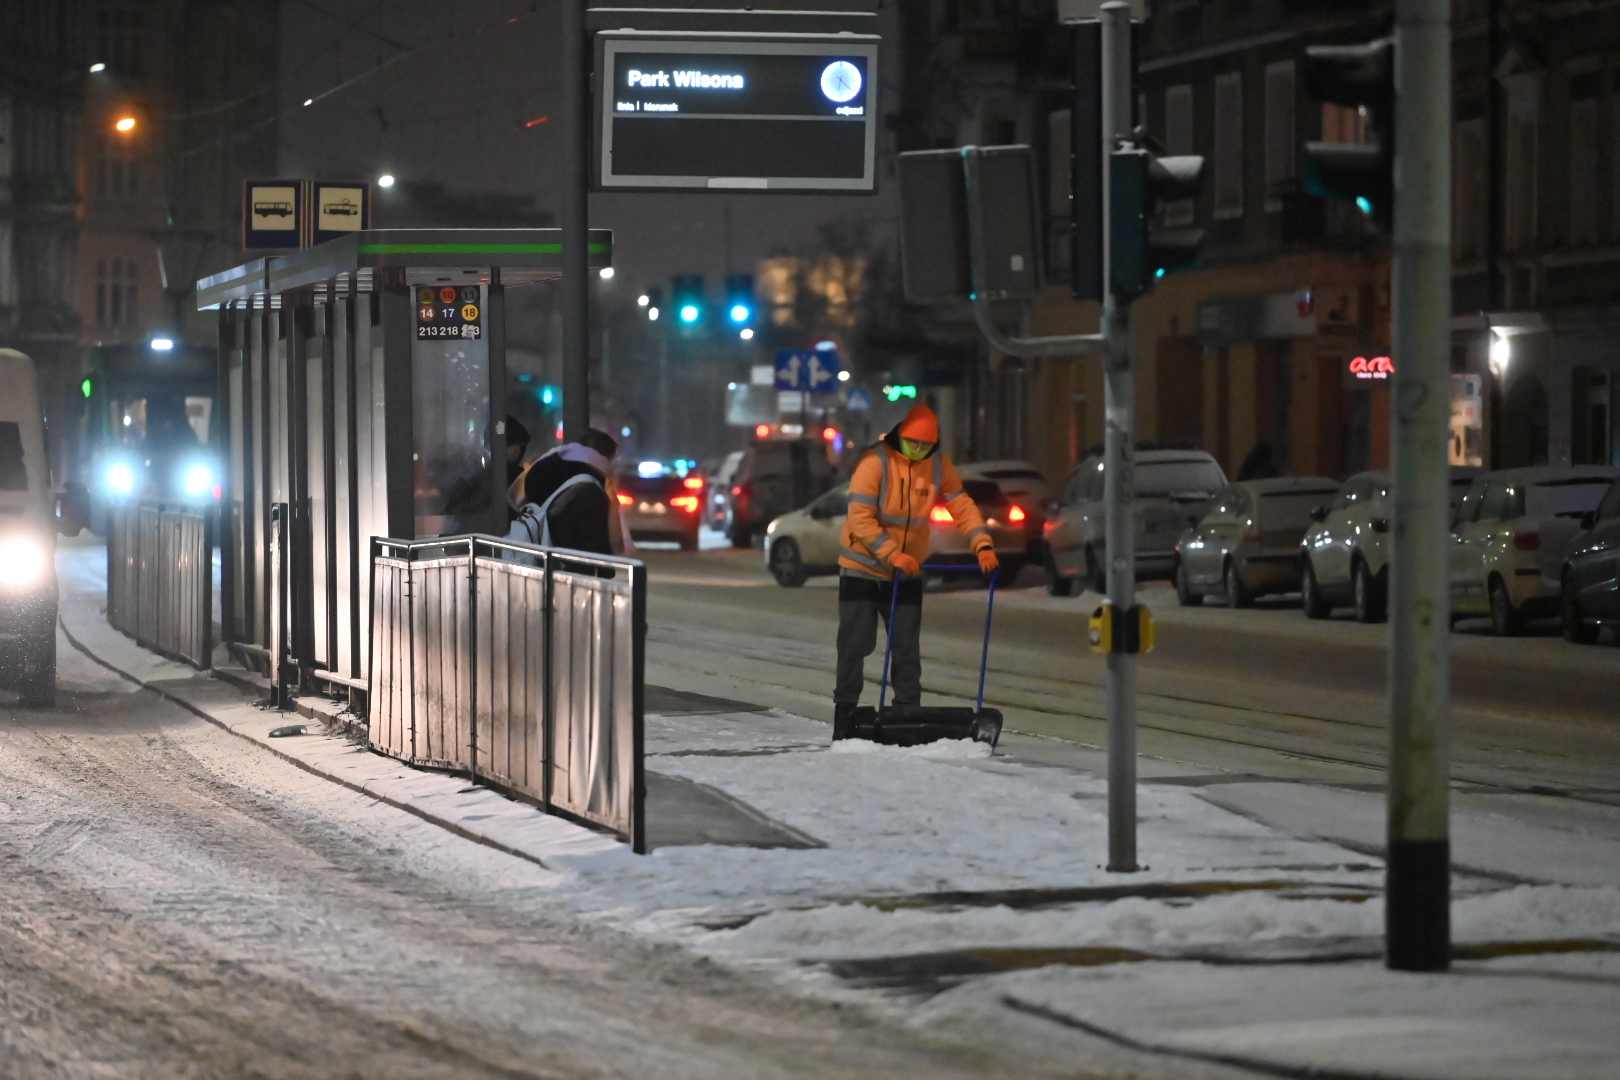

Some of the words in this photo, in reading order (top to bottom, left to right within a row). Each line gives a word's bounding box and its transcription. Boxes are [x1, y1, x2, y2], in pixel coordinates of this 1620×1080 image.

[628, 69, 670, 87] Park
[673, 70, 744, 89] Wilsona
[442, 290, 454, 300] 10
[464, 290, 474, 299] 11
[420, 308, 433, 318] 14
[442, 308, 455, 317] 17
[463, 308, 476, 317] 18
[419, 326, 438, 336] 213
[439, 326, 458, 336] 218
[1349, 356, 1396, 373] ara
